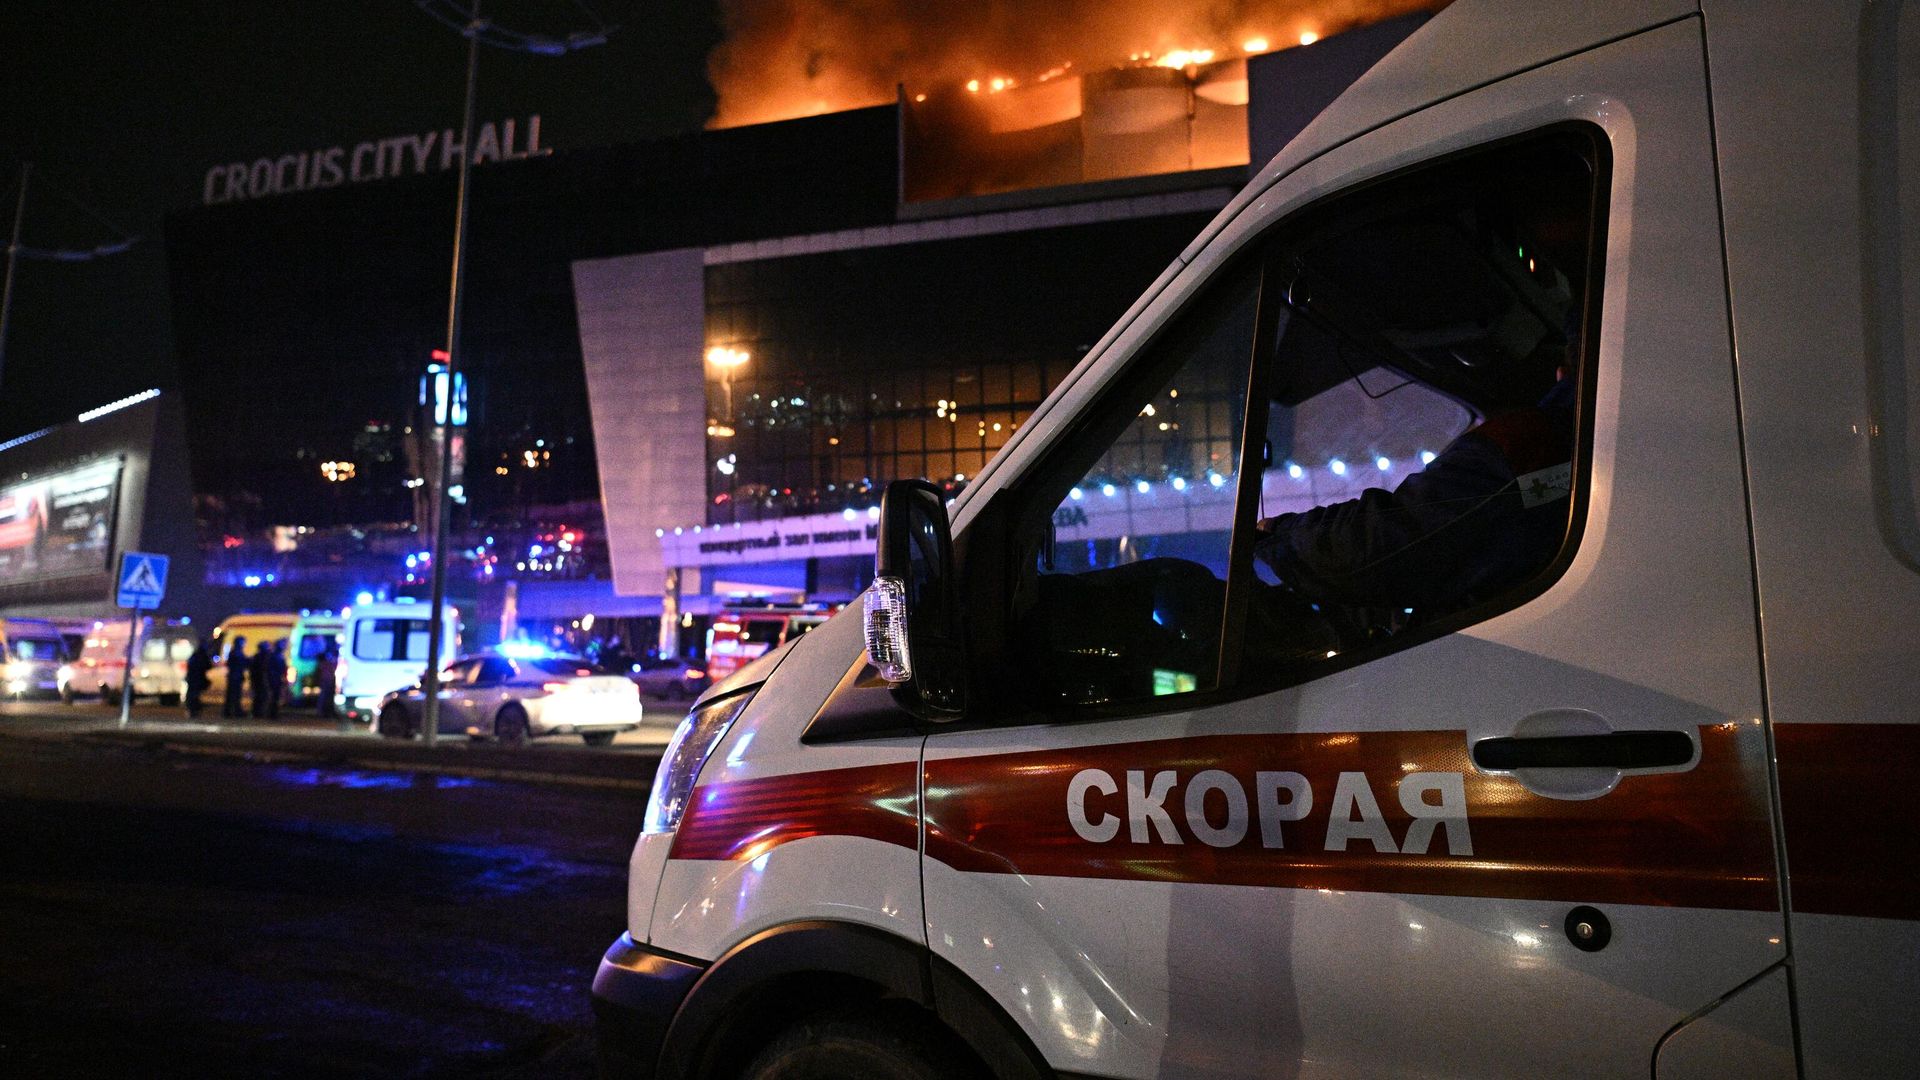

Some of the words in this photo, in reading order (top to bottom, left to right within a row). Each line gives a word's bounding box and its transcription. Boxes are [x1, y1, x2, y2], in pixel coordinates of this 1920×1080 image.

[203, 147, 346, 204] CROCUS
[350, 131, 438, 183] CITY
[440, 114, 553, 172] HALL
[1066, 768, 1474, 857] СКОРАЯ
